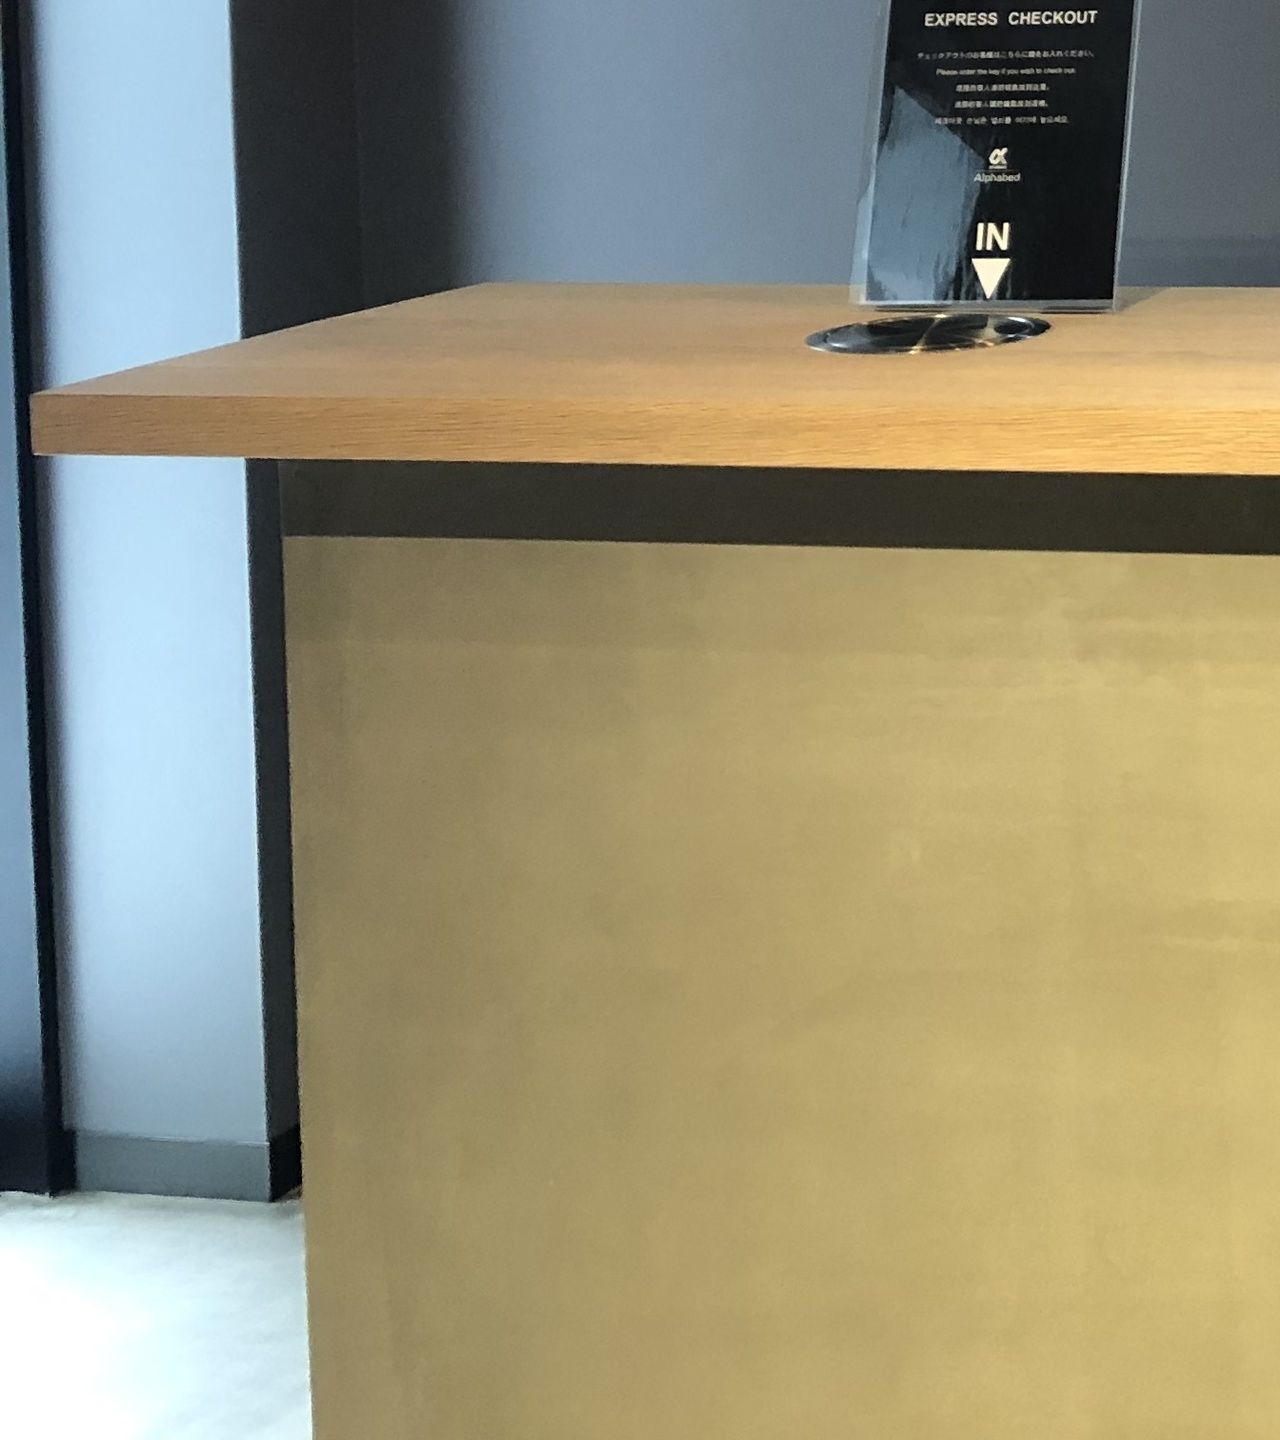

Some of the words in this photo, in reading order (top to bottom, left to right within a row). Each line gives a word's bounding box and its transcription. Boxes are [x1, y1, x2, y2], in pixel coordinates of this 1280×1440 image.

[924, 12, 998, 27] EXPRESS
[1008, 10, 1099, 26] CHECKOUT
[973, 172, 1021, 183] Alphabed
[975, 221, 1011, 251] IN
